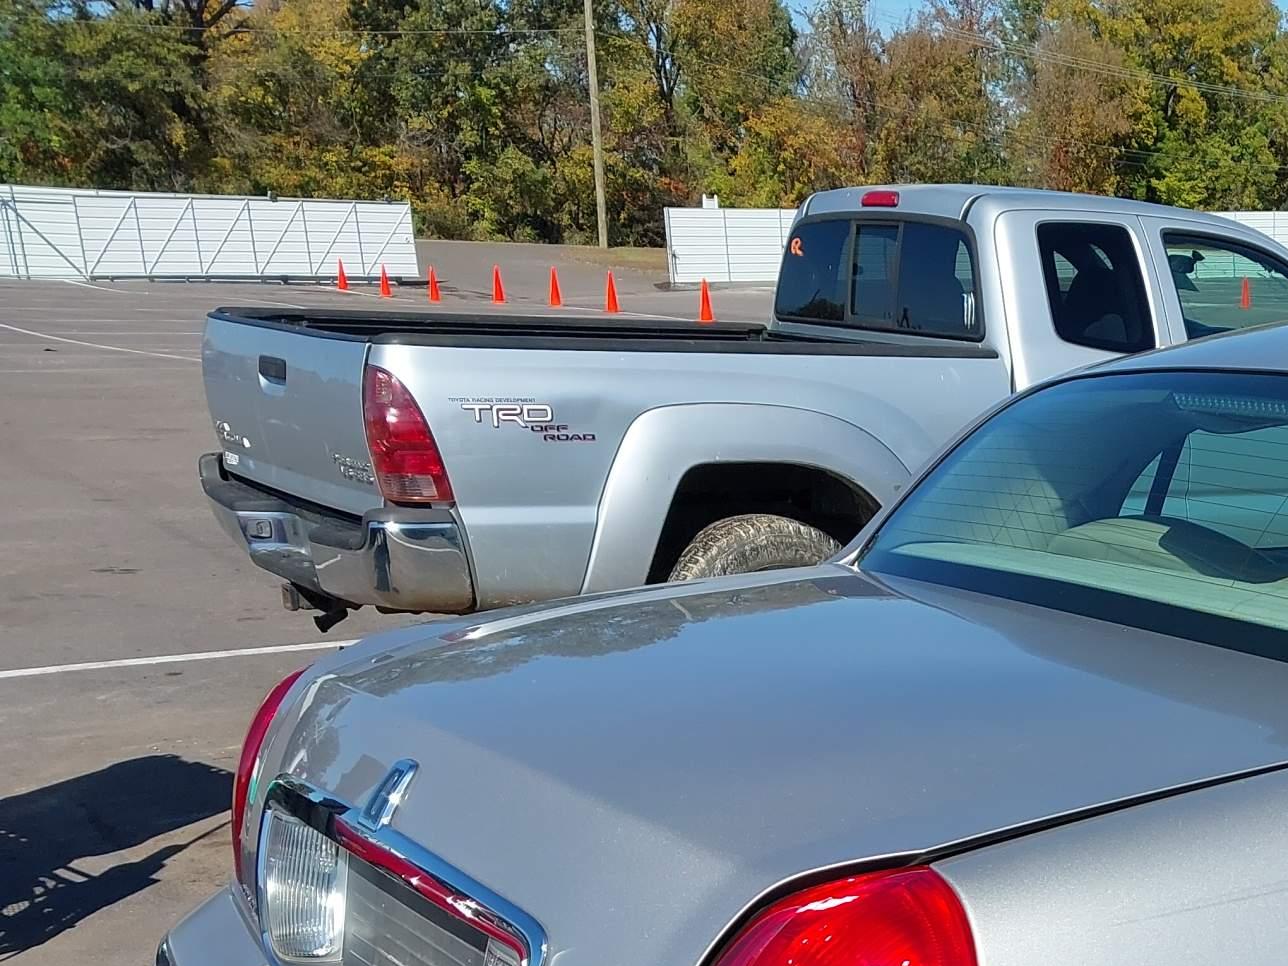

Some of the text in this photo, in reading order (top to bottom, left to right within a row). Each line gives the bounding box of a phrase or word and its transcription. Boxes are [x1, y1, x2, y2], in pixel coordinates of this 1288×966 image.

[460, 404, 554, 429] TRD
[530, 424, 569, 433] OFF
[543, 433, 597, 442] ROAD
